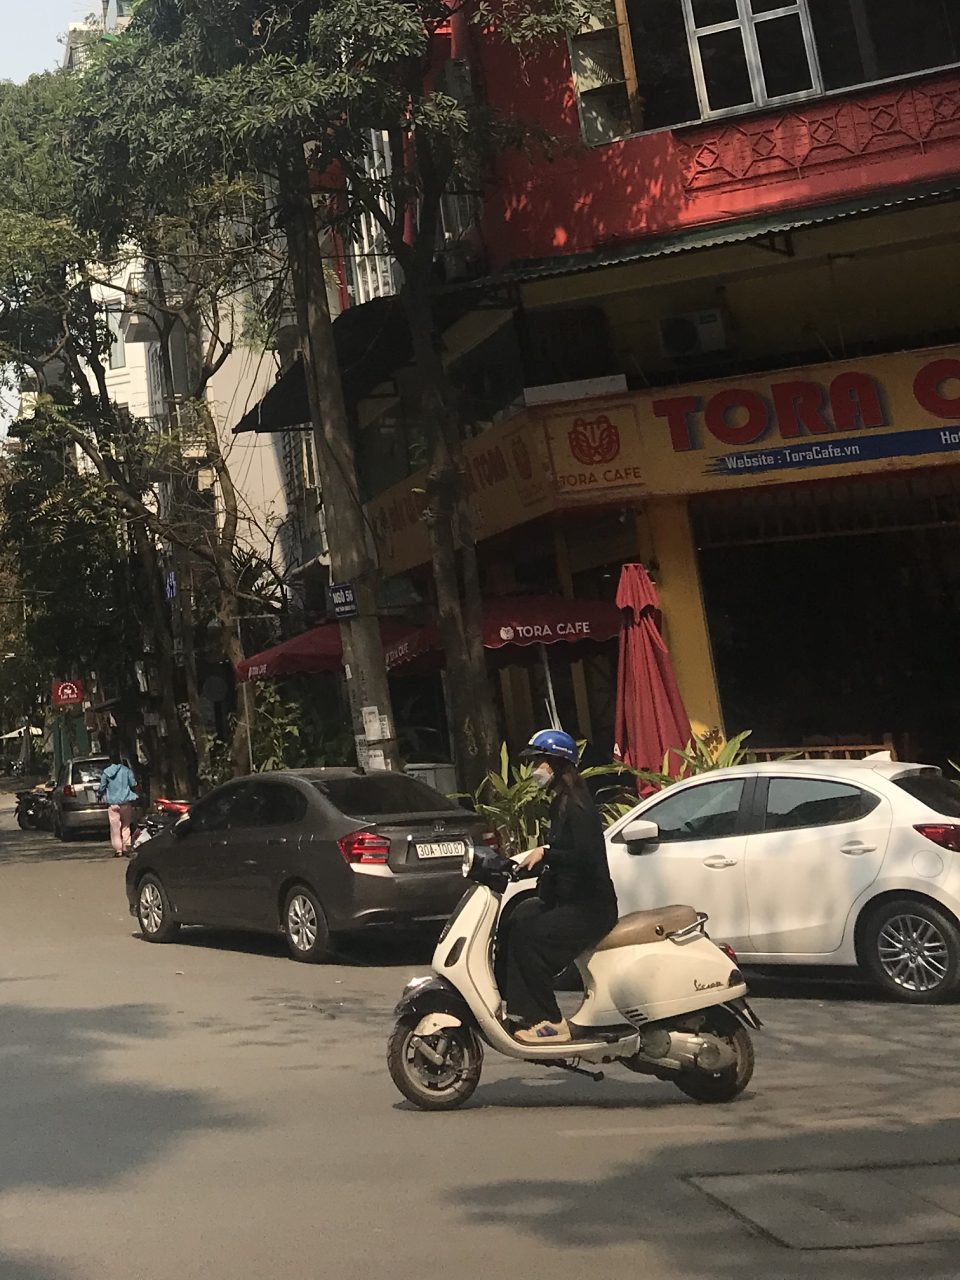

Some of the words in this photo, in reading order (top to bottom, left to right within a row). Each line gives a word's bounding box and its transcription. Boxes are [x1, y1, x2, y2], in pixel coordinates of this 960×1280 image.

[652, 371, 885, 453] TORA
[724, 454, 774, 469] Website
[784, 444, 860, 463] ToraCafe.vn
[559, 472, 598, 488] TORA
[603, 467, 642, 482] CAFE
[516, 625, 553, 638] TORA
[557, 621, 590, 635] CAFE
